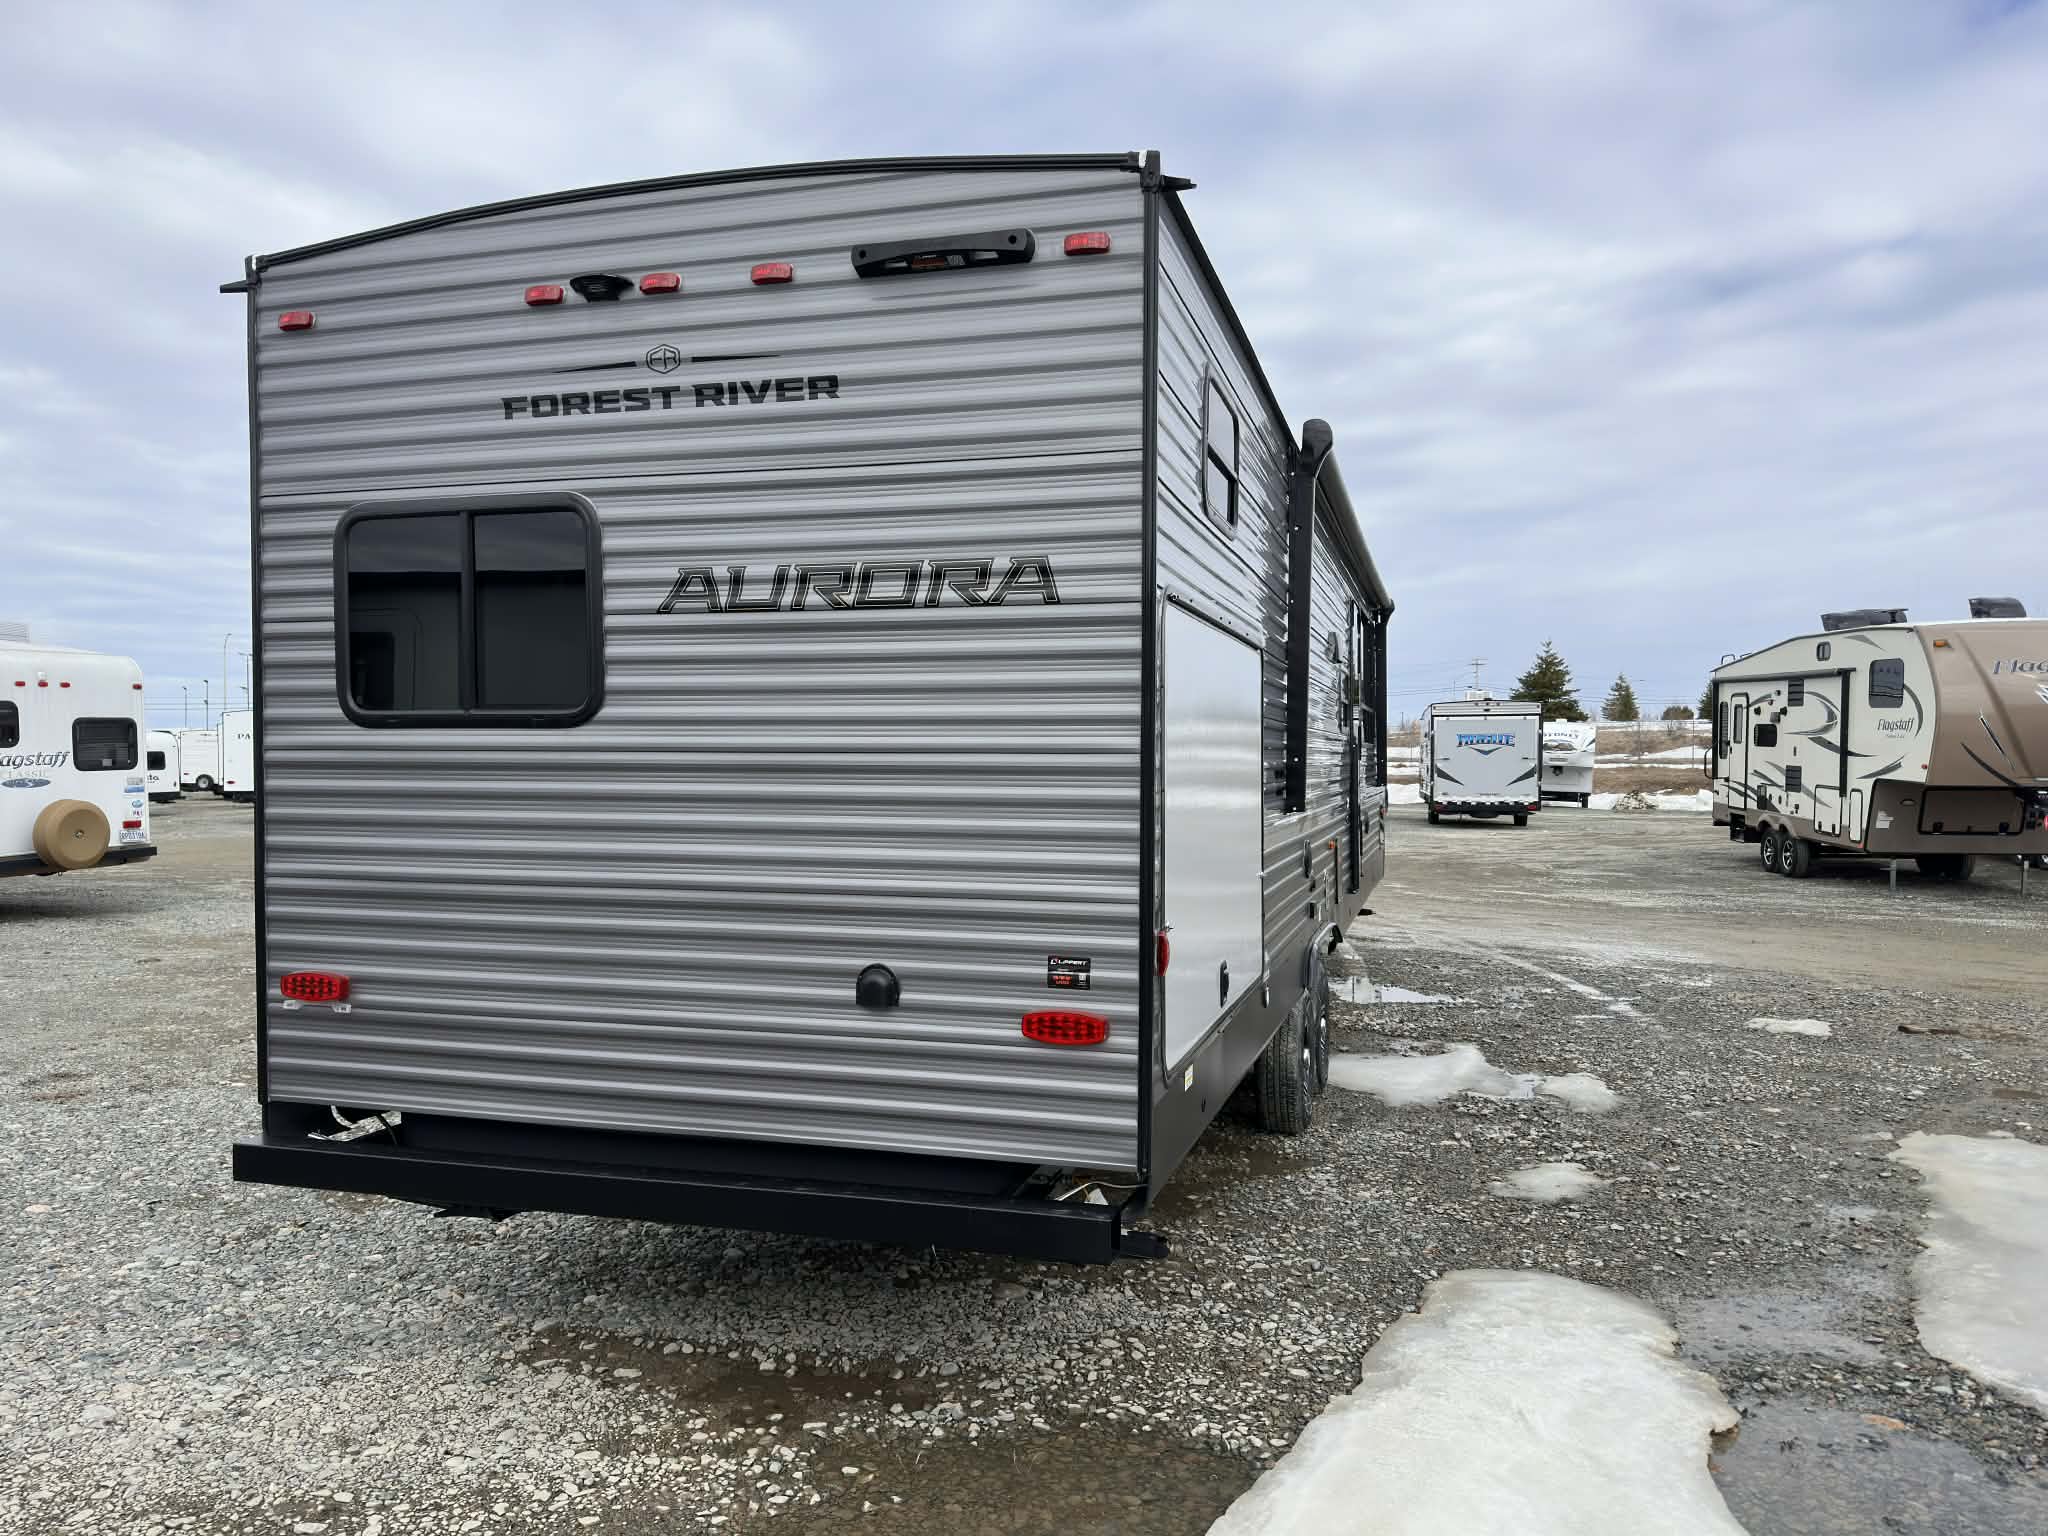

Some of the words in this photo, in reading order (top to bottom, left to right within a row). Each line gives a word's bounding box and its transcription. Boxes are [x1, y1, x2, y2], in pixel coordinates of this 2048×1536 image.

[501, 386, 681, 420] FOREST
[691, 374, 841, 408] RIVER
[656, 555, 1061, 614] AURORA
[1877, 718, 1915, 733] Flagstaff
[0, 751, 70, 770] agstaff
